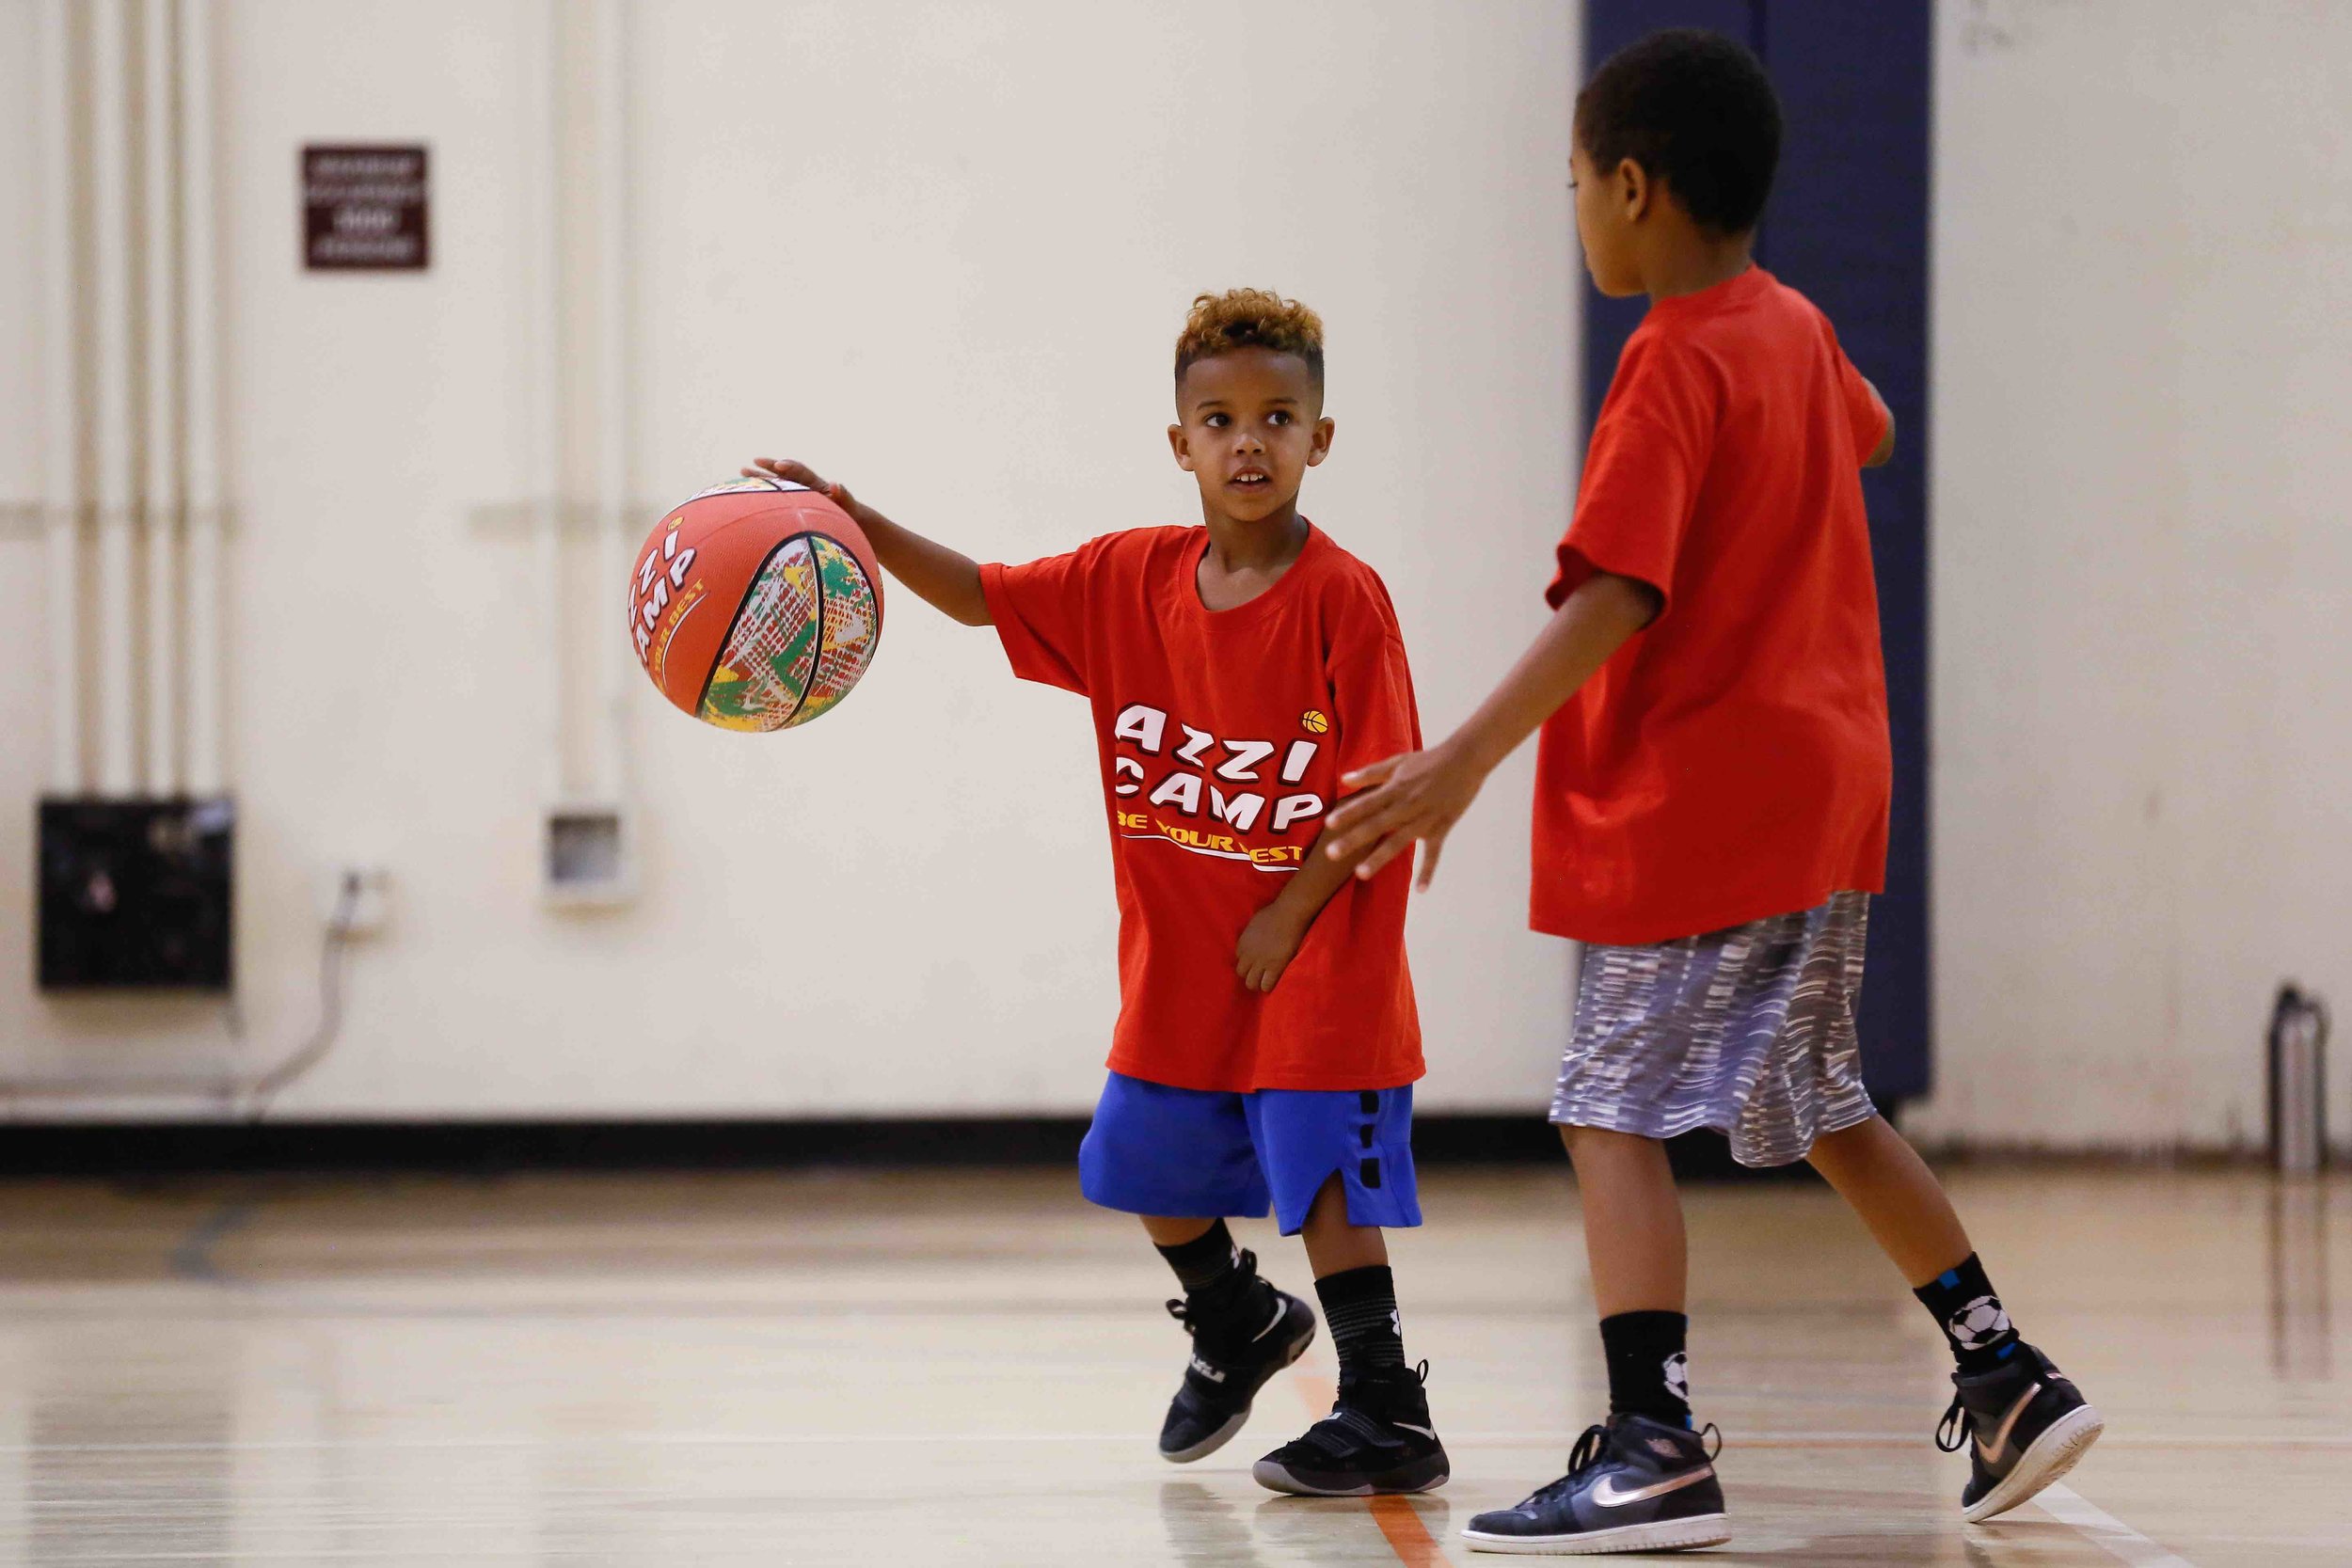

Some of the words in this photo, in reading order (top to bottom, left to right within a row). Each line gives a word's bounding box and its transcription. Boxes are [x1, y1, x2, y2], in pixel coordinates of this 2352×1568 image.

[636, 546, 696, 663] AMP
[668, 578, 704, 626] BEST
[1114, 704, 1319, 784] AZZI
[1238, 843, 1303, 863] EST
